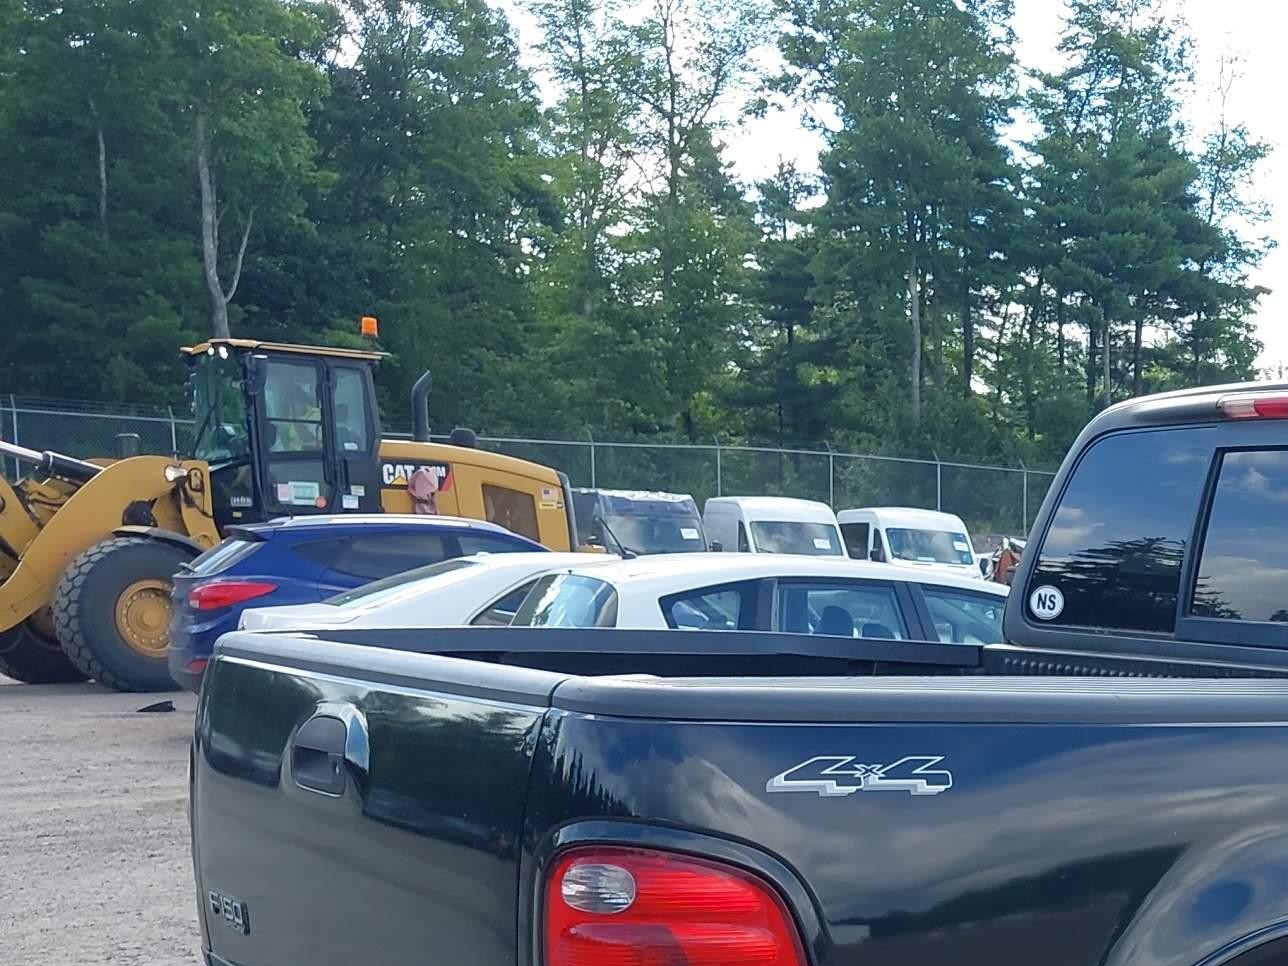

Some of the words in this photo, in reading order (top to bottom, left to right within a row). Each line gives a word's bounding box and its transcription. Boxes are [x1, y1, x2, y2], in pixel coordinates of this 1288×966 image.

[382, 463, 416, 485] CAT
[1036, 592, 1057, 611] NS
[765, 755, 953, 797] 4x4
